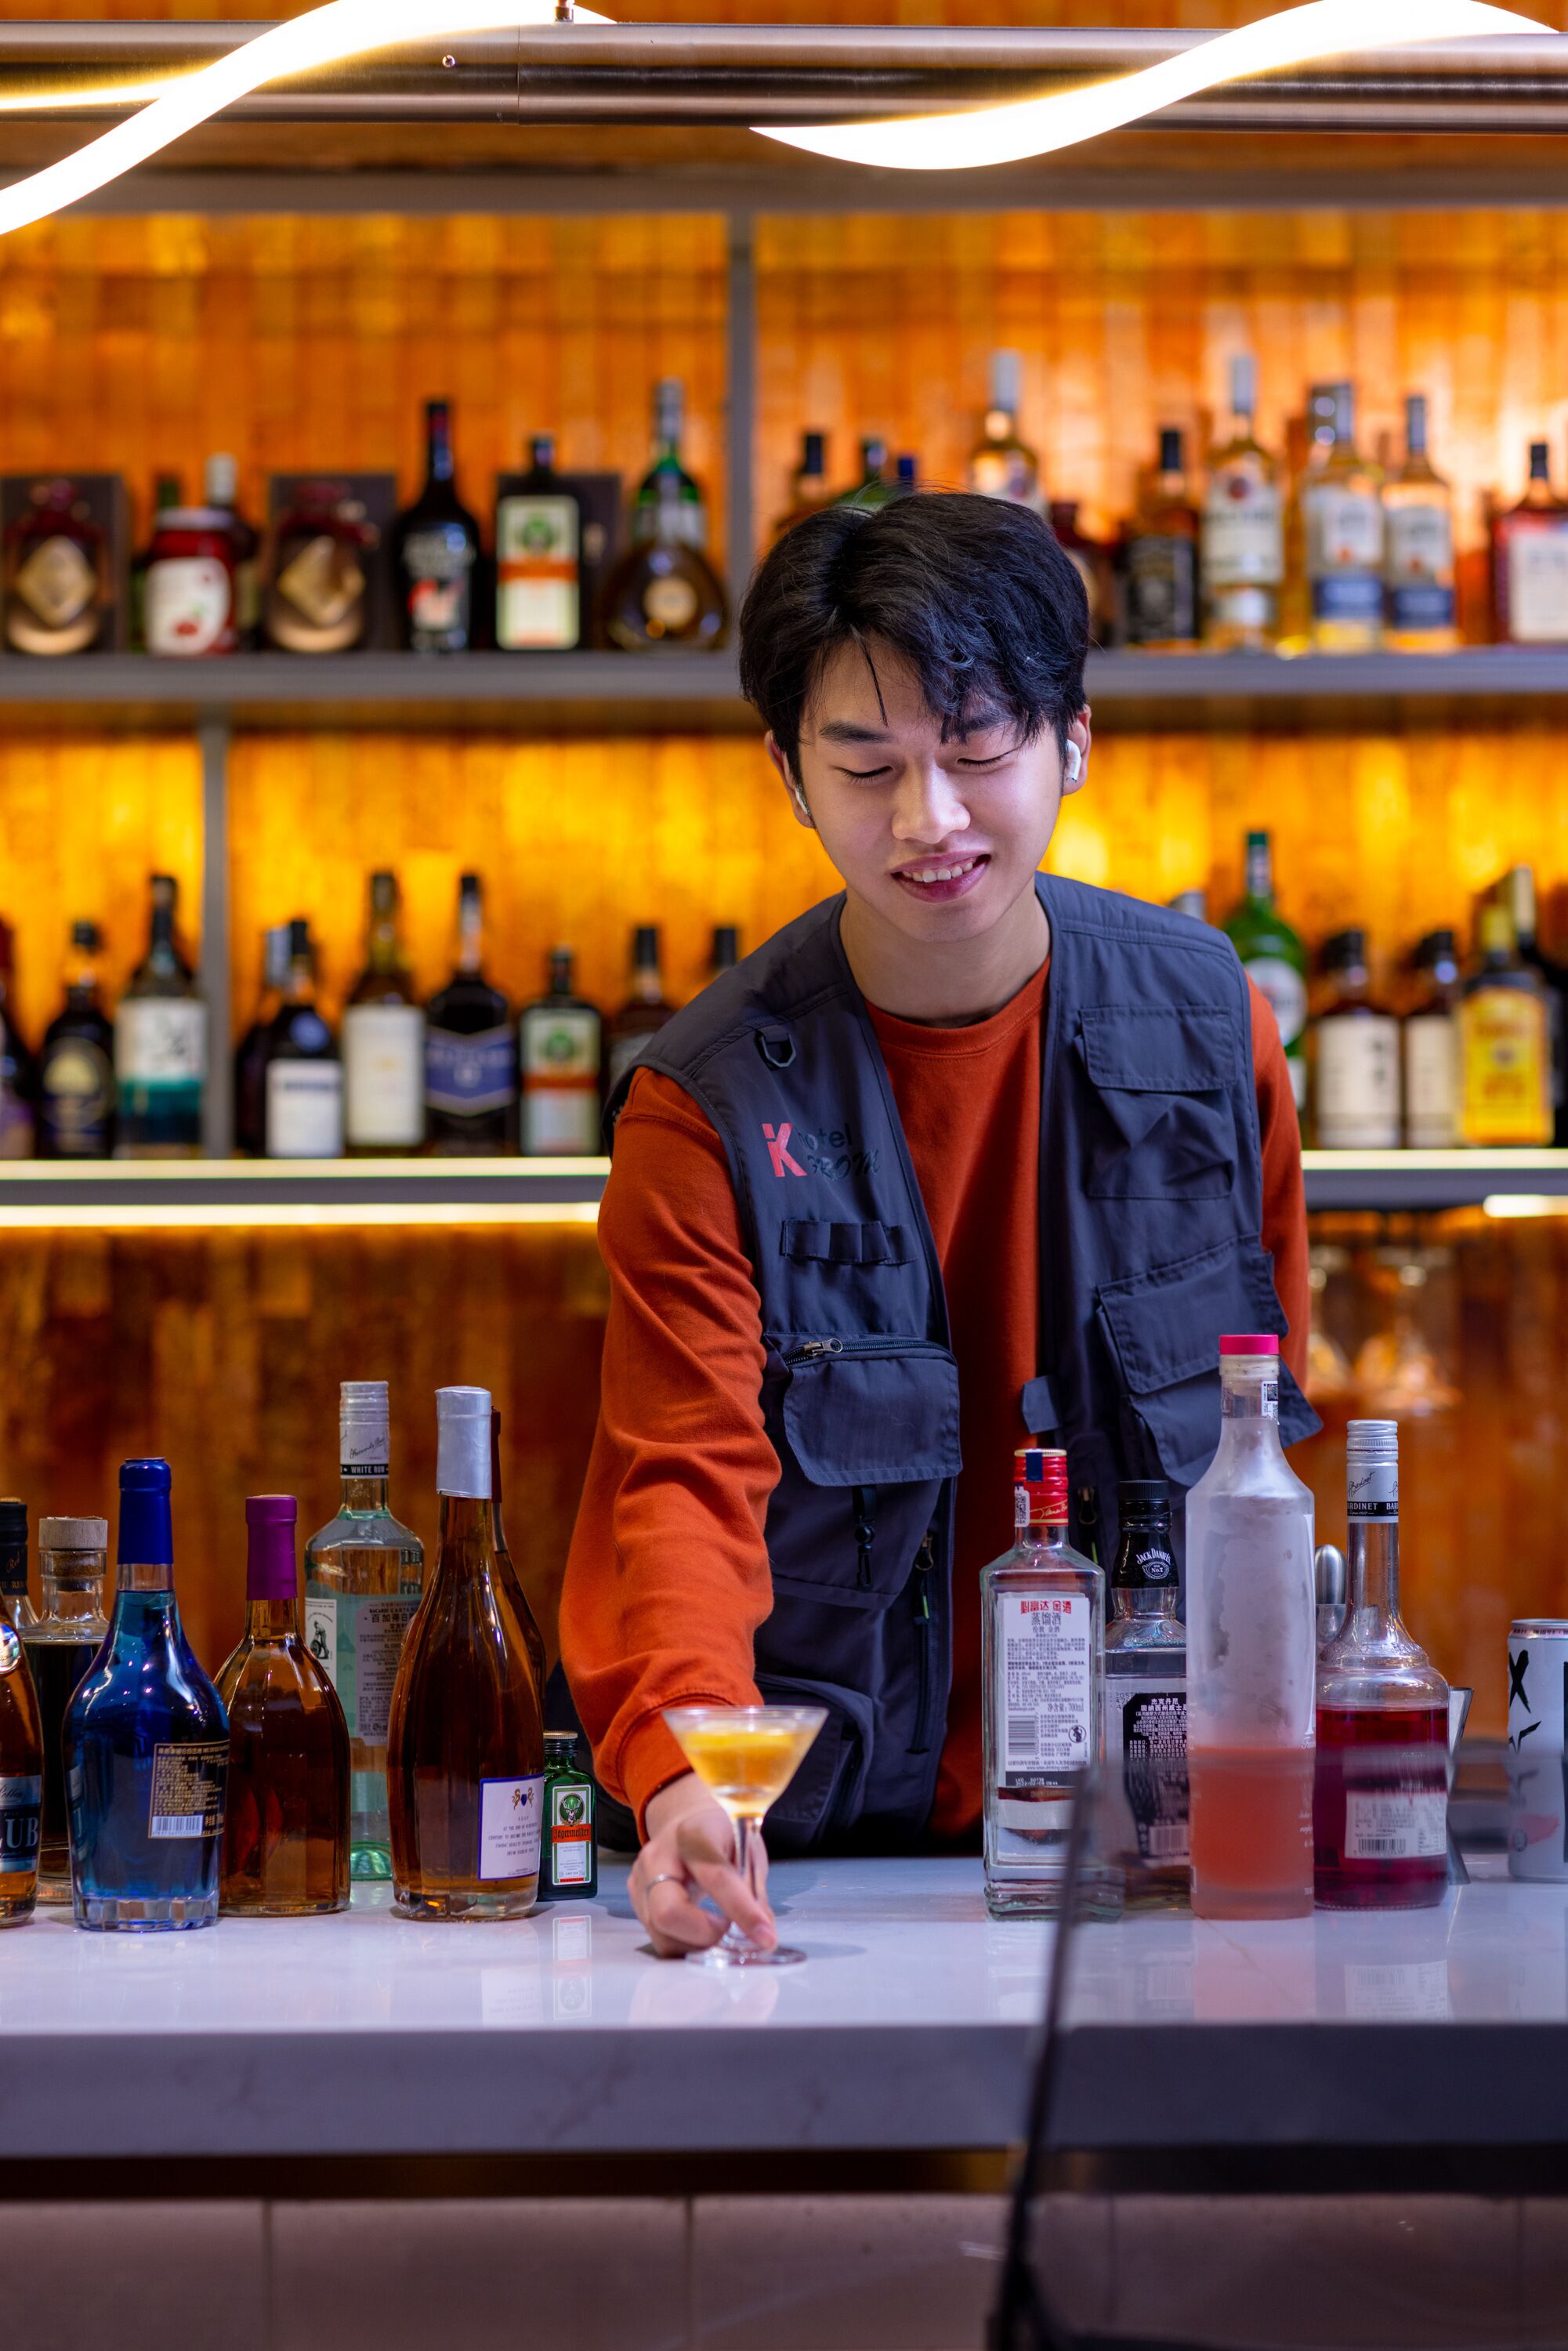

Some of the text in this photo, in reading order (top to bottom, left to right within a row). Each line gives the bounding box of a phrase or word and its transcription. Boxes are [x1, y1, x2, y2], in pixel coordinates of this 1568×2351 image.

[350, 1465, 372, 1474] WHITE
[1135, 1551, 1153, 1565] JACK
[0, 1817, 38, 1849] UB
